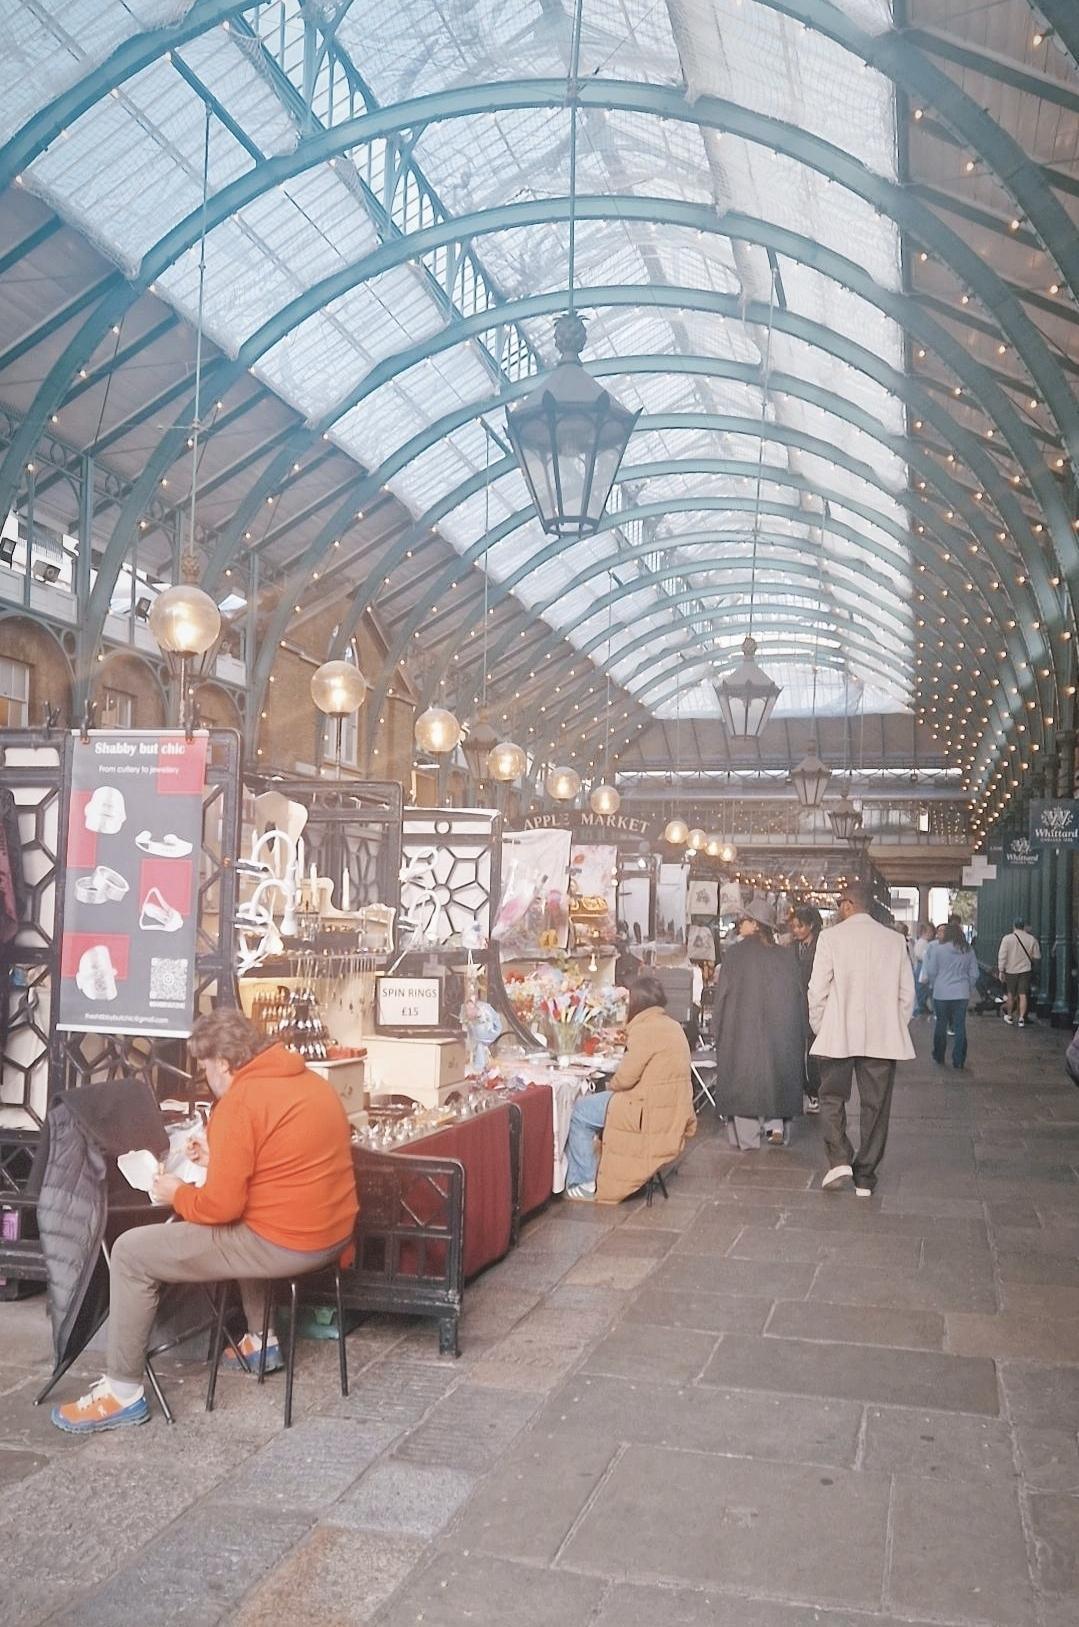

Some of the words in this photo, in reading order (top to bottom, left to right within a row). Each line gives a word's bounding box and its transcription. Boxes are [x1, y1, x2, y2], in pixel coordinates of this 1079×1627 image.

[94, 741, 137, 757] Shabby
[139, 741, 159, 755] but
[160, 741, 186, 755] chic
[141, 765, 149, 774] to
[523, 812, 570, 831] APPLE
[581, 812, 650, 834] MARKET
[1035, 828, 1079, 838] Whittard
[1006, 853, 1039, 861] Whittard
[382, 988, 405, 998] SPIN
[408, 988, 437, 998] RINGS
[401, 1006, 419, 1017] £15
